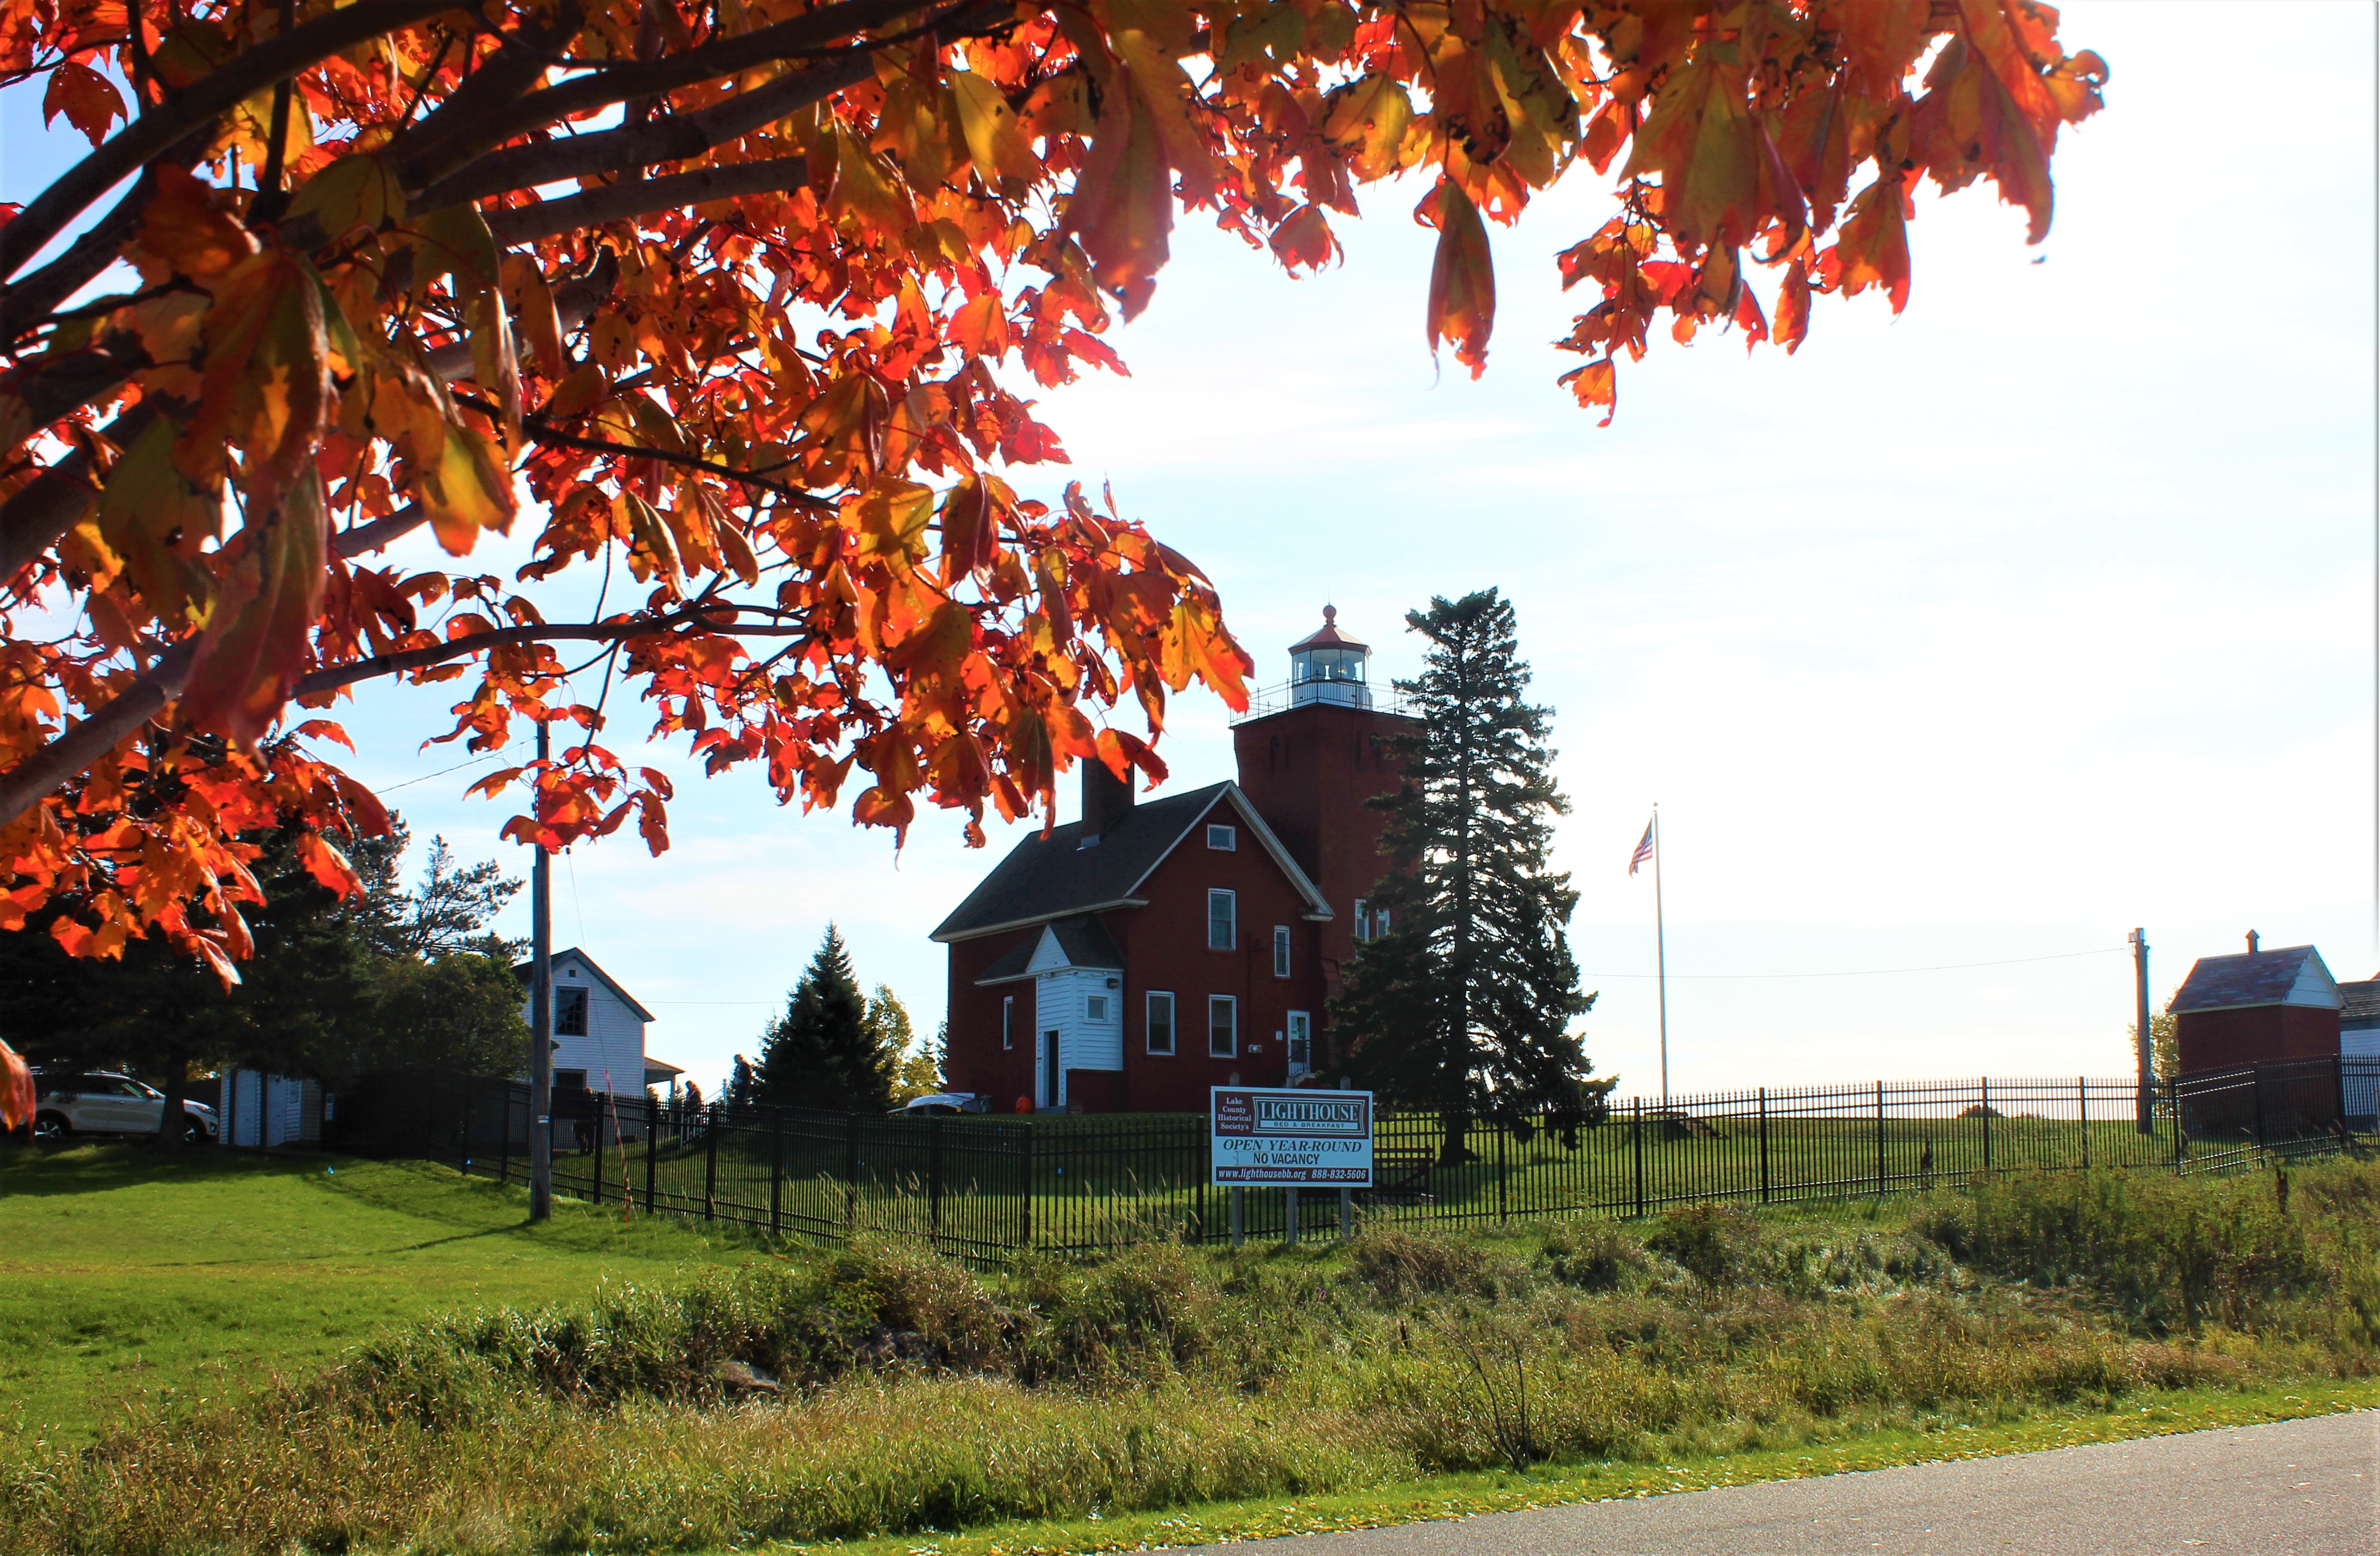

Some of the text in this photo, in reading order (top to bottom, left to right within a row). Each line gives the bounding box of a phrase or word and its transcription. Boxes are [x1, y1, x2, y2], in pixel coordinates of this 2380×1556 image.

[1222, 1106, 1246, 1114] County
[1261, 1103, 1358, 1121] LIGHTHOUSE
[1221, 1123, 1249, 1131] Society's
[1223, 1139, 1362, 1152] OPEN YEAR-ROUND
[1253, 1153, 1320, 1164] NO VACANCY
[1219, 1168, 1366, 1180] www.lighthousebb.org 888-832-5606
